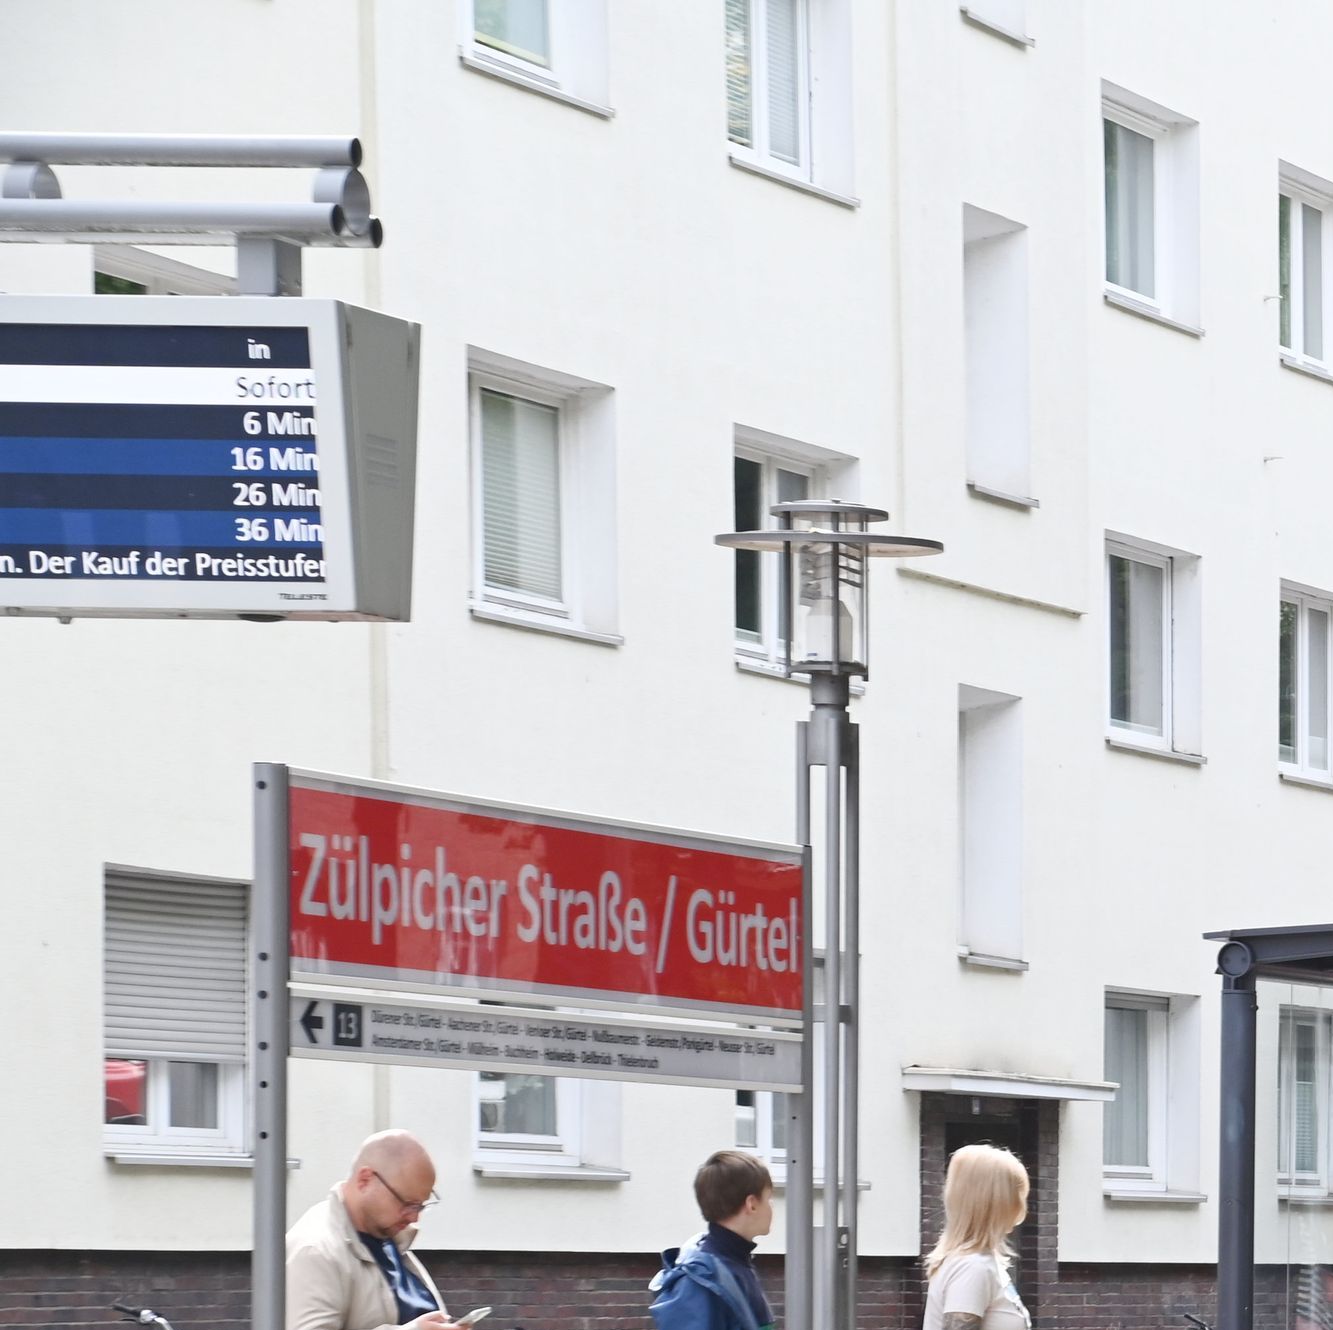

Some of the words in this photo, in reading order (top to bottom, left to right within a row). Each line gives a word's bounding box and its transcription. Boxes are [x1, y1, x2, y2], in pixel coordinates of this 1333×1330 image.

[247, 338, 271, 359] in
[236, 375, 316, 399] Sofort
[243, 411, 262, 435] 6
[266, 411, 318, 435] Min
[231, 446, 264, 470] 16
[269, 446, 320, 471] Min
[232, 483, 267, 506] 26
[271, 483, 322, 506] Min
[234, 518, 269, 541] 36
[274, 518, 325, 541] Min
[29, 550, 76, 574] Der
[82, 551, 140, 575] Kauf
[145, 551, 190, 575] der
[300, 832, 508, 944] Zülpicher
[338, 1011, 358, 1039] 13
